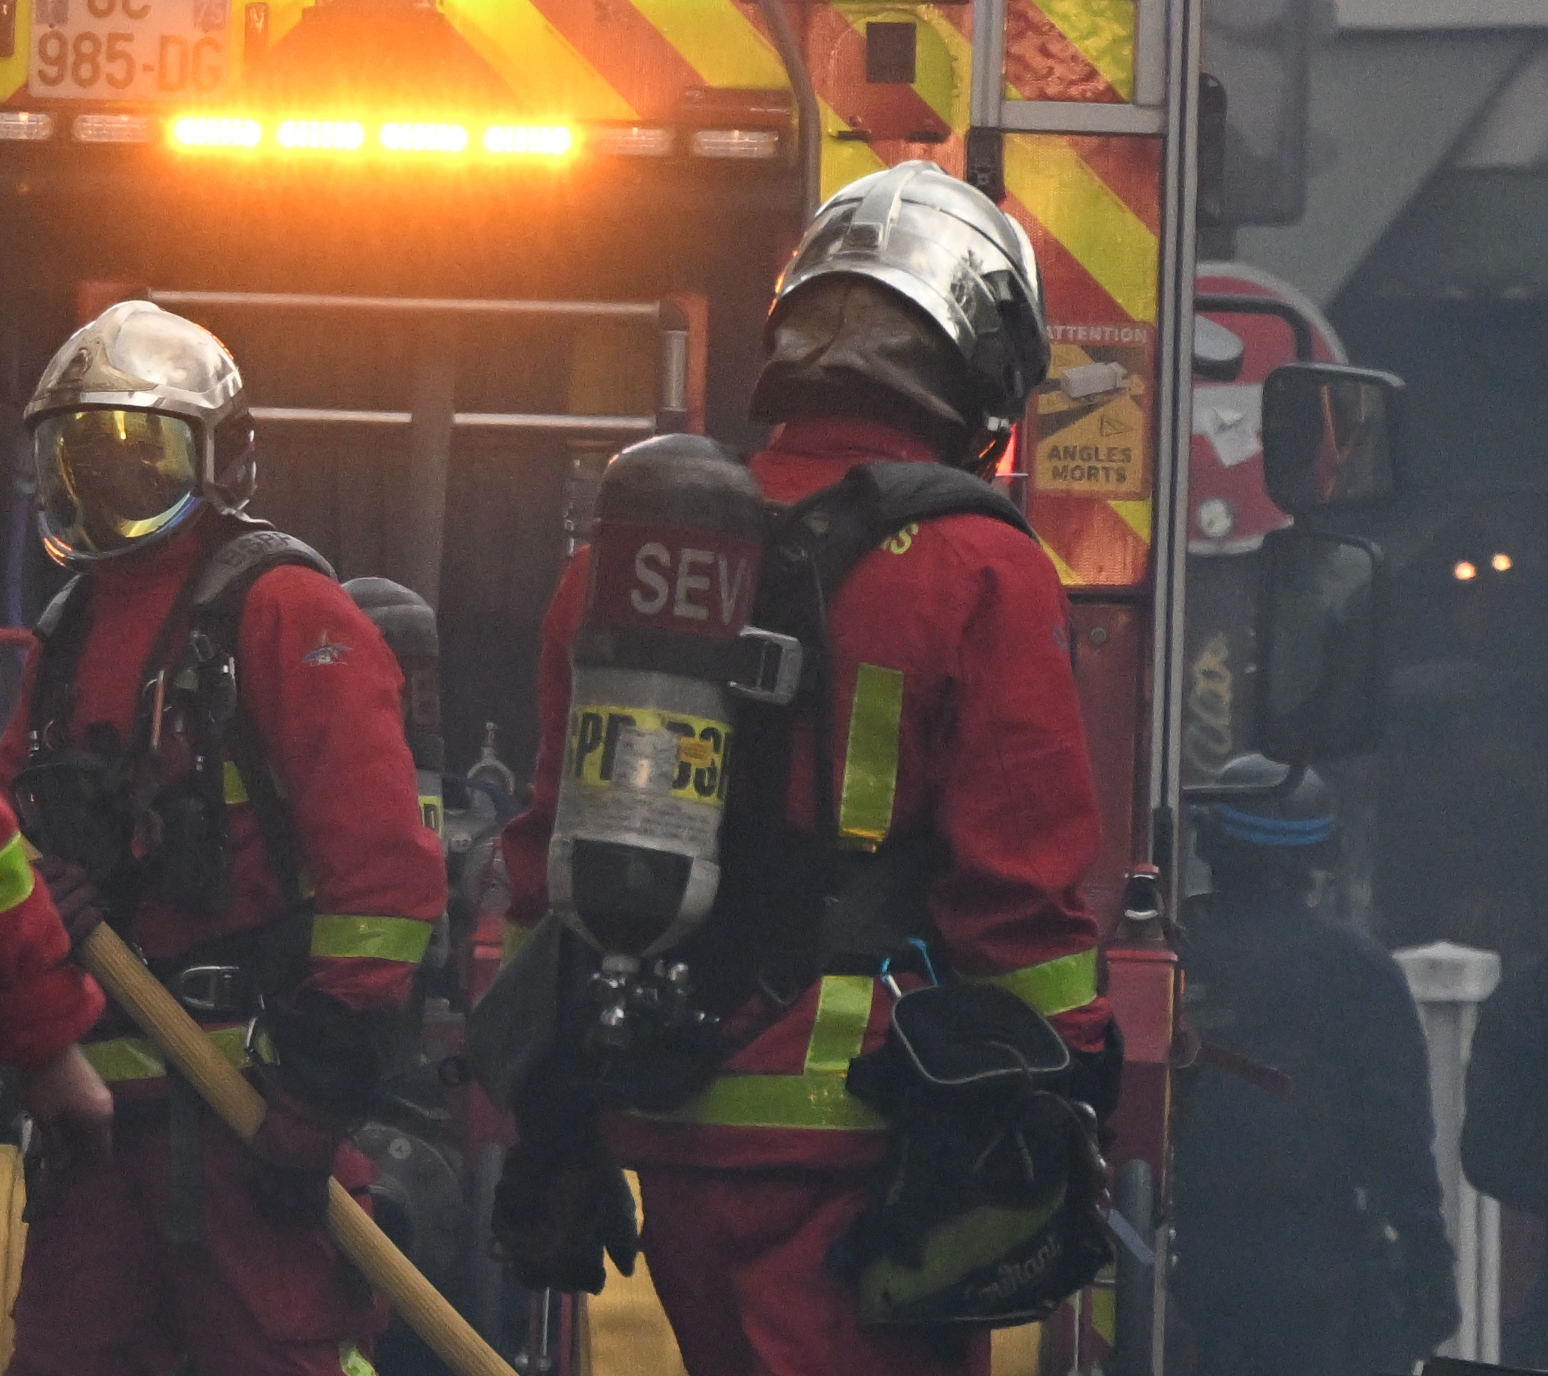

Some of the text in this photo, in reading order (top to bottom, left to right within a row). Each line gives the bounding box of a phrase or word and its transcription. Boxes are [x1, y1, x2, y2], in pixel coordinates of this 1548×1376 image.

[1046, 324, 1147, 343] ATTENTION
[1047, 444, 1133, 463] ANGLES
[1050, 465, 1128, 484] MORTS
